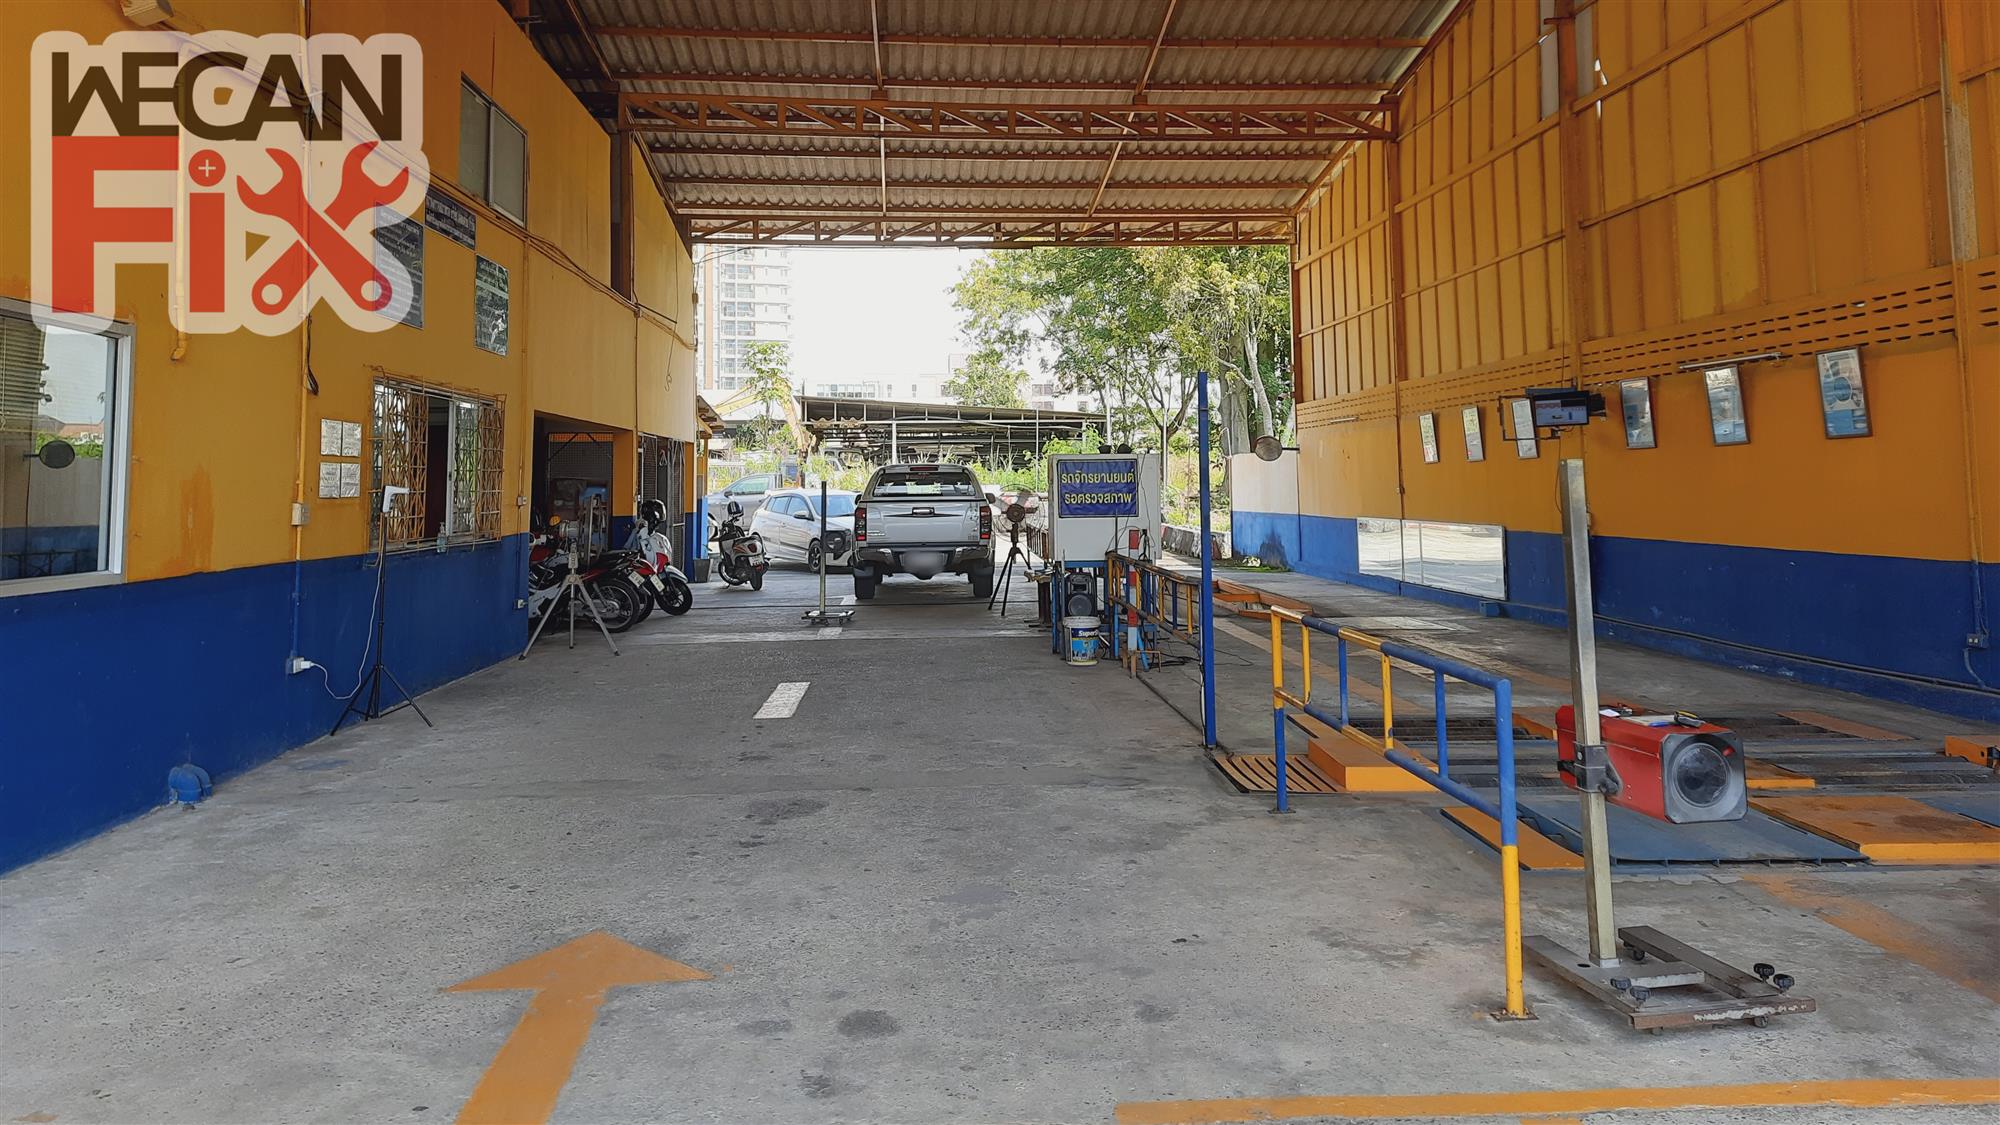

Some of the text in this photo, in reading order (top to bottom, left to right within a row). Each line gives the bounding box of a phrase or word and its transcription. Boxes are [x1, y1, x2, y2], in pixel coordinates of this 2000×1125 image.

[1061, 468, 1135, 484] รถจักรยานยนต์
[1064, 493, 1132, 504] รอตรวจสภาพ
